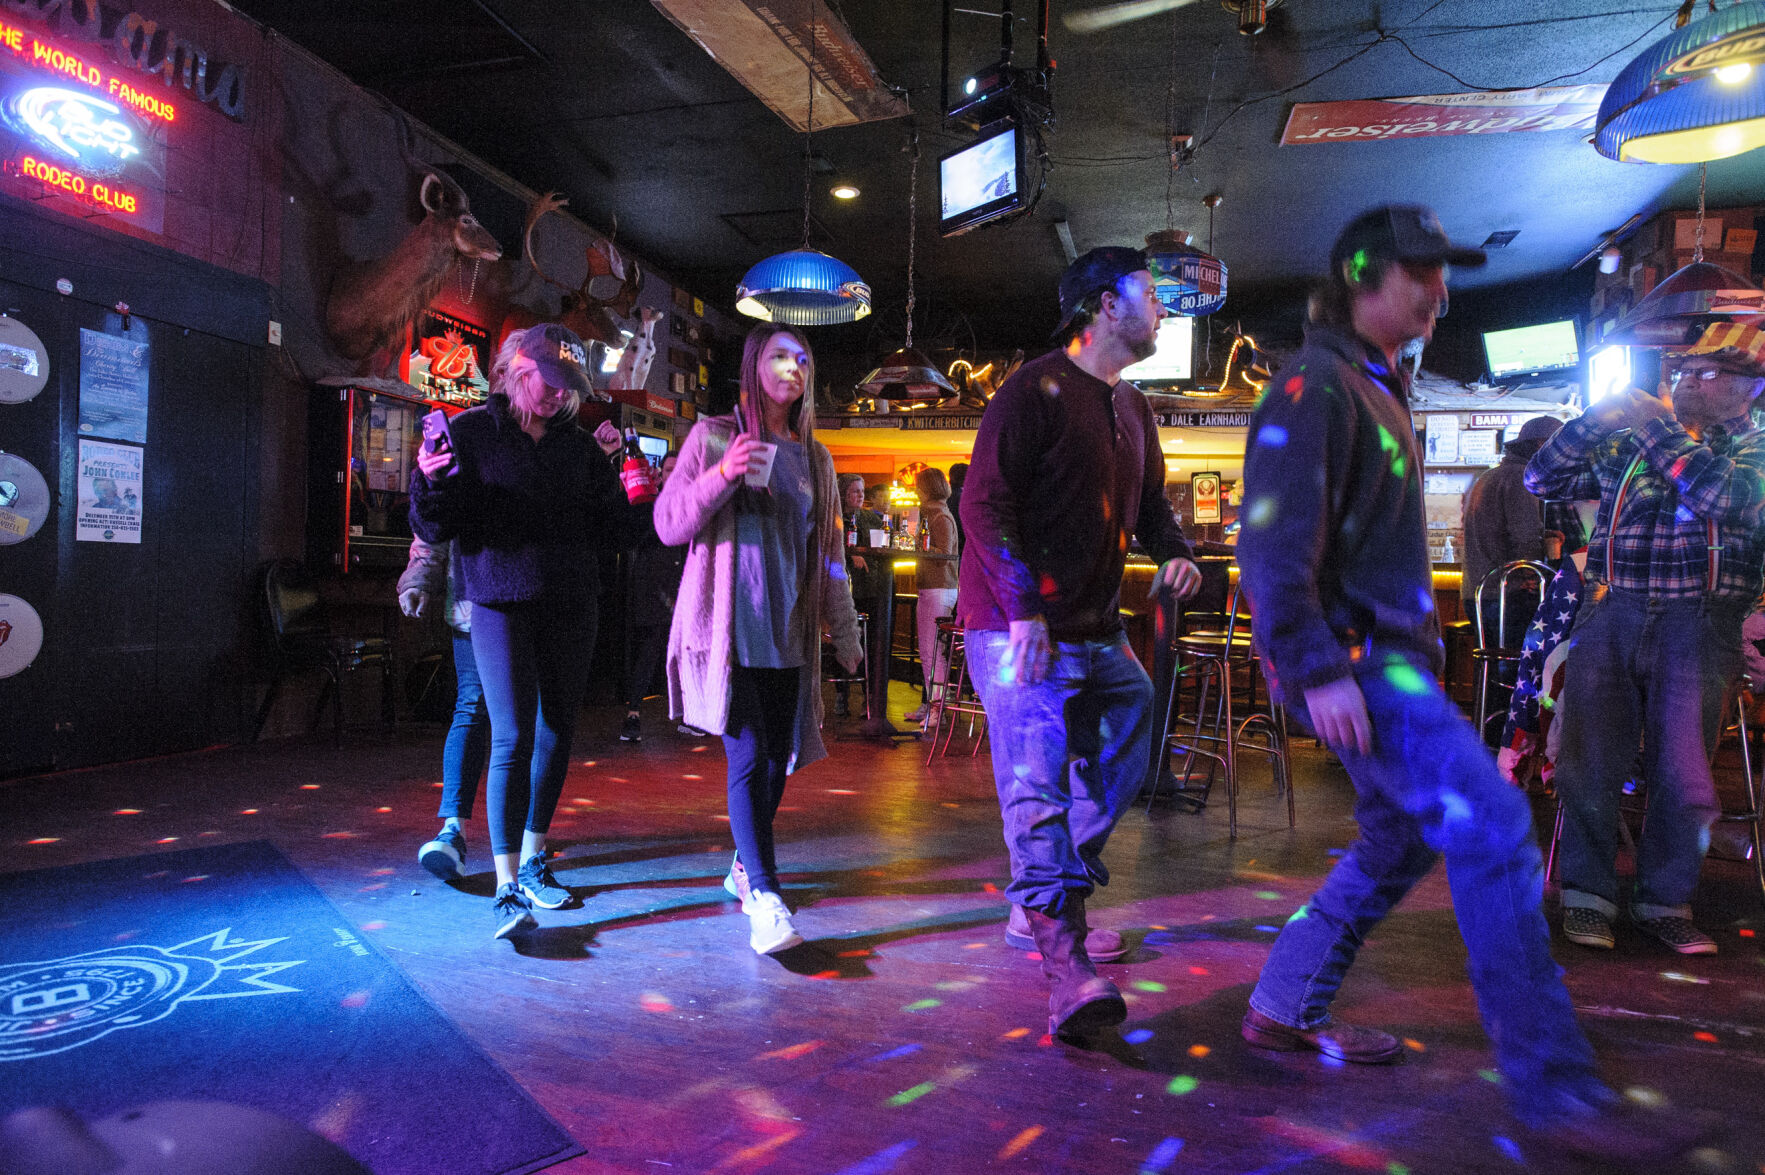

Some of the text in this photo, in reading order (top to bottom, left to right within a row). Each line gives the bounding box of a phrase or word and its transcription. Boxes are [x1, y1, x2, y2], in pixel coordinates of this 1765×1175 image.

[34, 40, 101, 86] WORLD
[109, 78, 175, 121] FAMOUS
[23, 157, 136, 213] RODEO CLUB
[418, 370, 481, 400] TRUE
[1171, 413, 1194, 426] DALE
[1475, 415, 1509, 426] BAMA
[82, 465, 107, 477] JOHN
[71, 977, 145, 1019] SINCE
